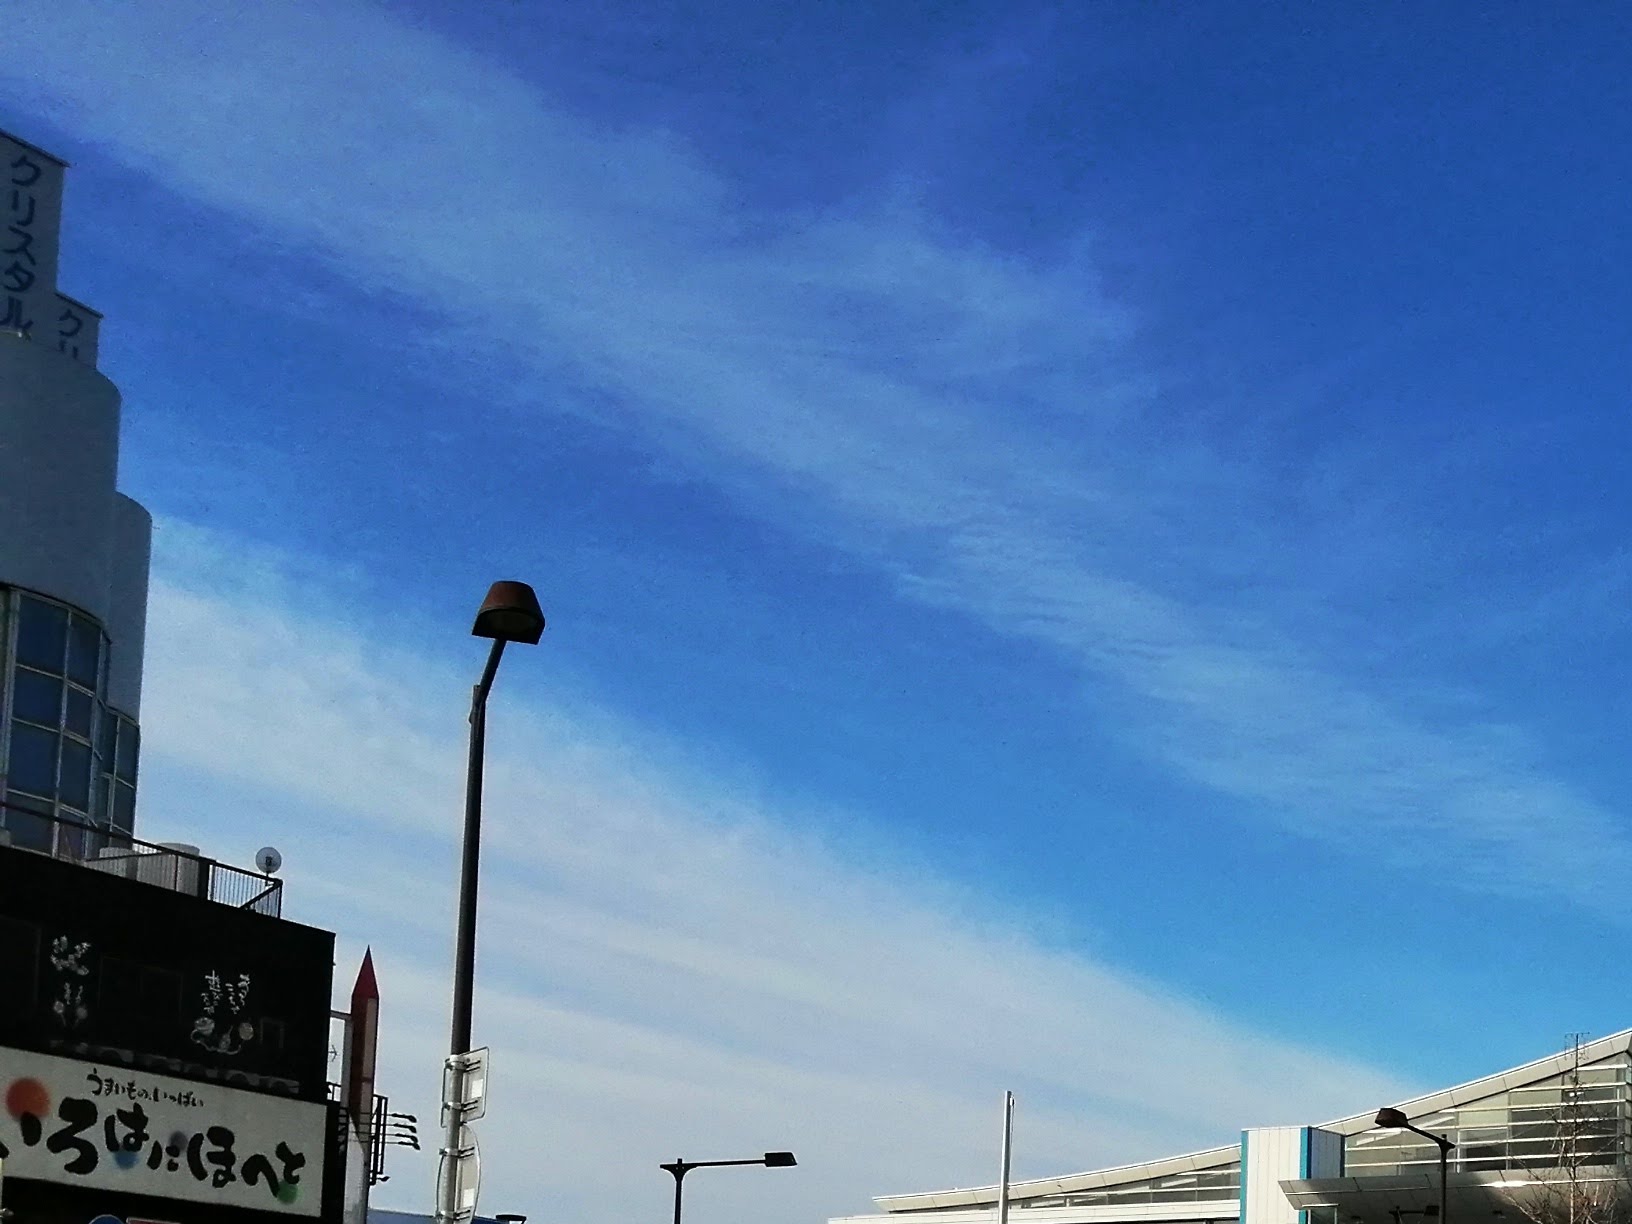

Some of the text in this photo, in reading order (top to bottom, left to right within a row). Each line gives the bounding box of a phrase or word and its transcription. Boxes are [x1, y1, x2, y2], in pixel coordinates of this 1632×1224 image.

[0, 155, 42, 332] クリスタル
